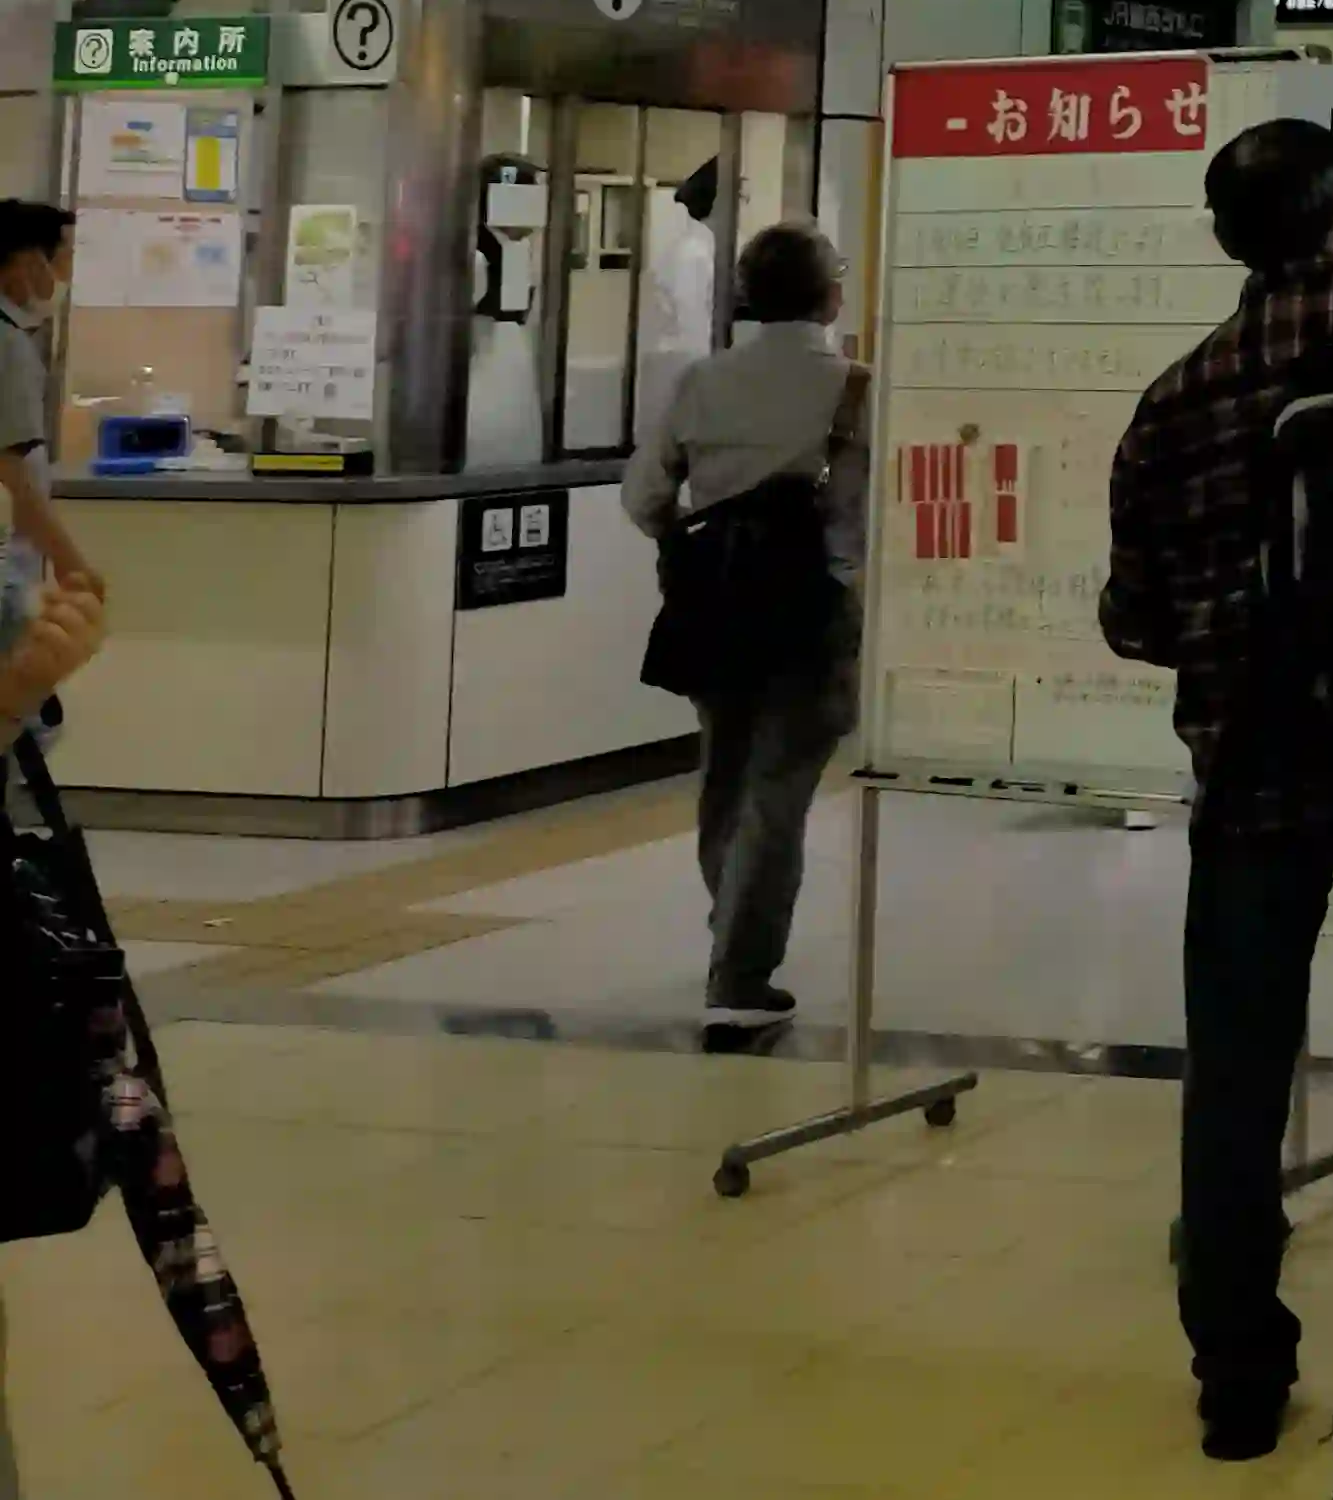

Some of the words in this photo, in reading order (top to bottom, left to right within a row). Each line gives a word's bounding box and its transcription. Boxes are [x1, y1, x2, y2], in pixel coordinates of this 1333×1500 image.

[128, 26, 247, 57] 案内所
[132, 55, 238, 73] Information
